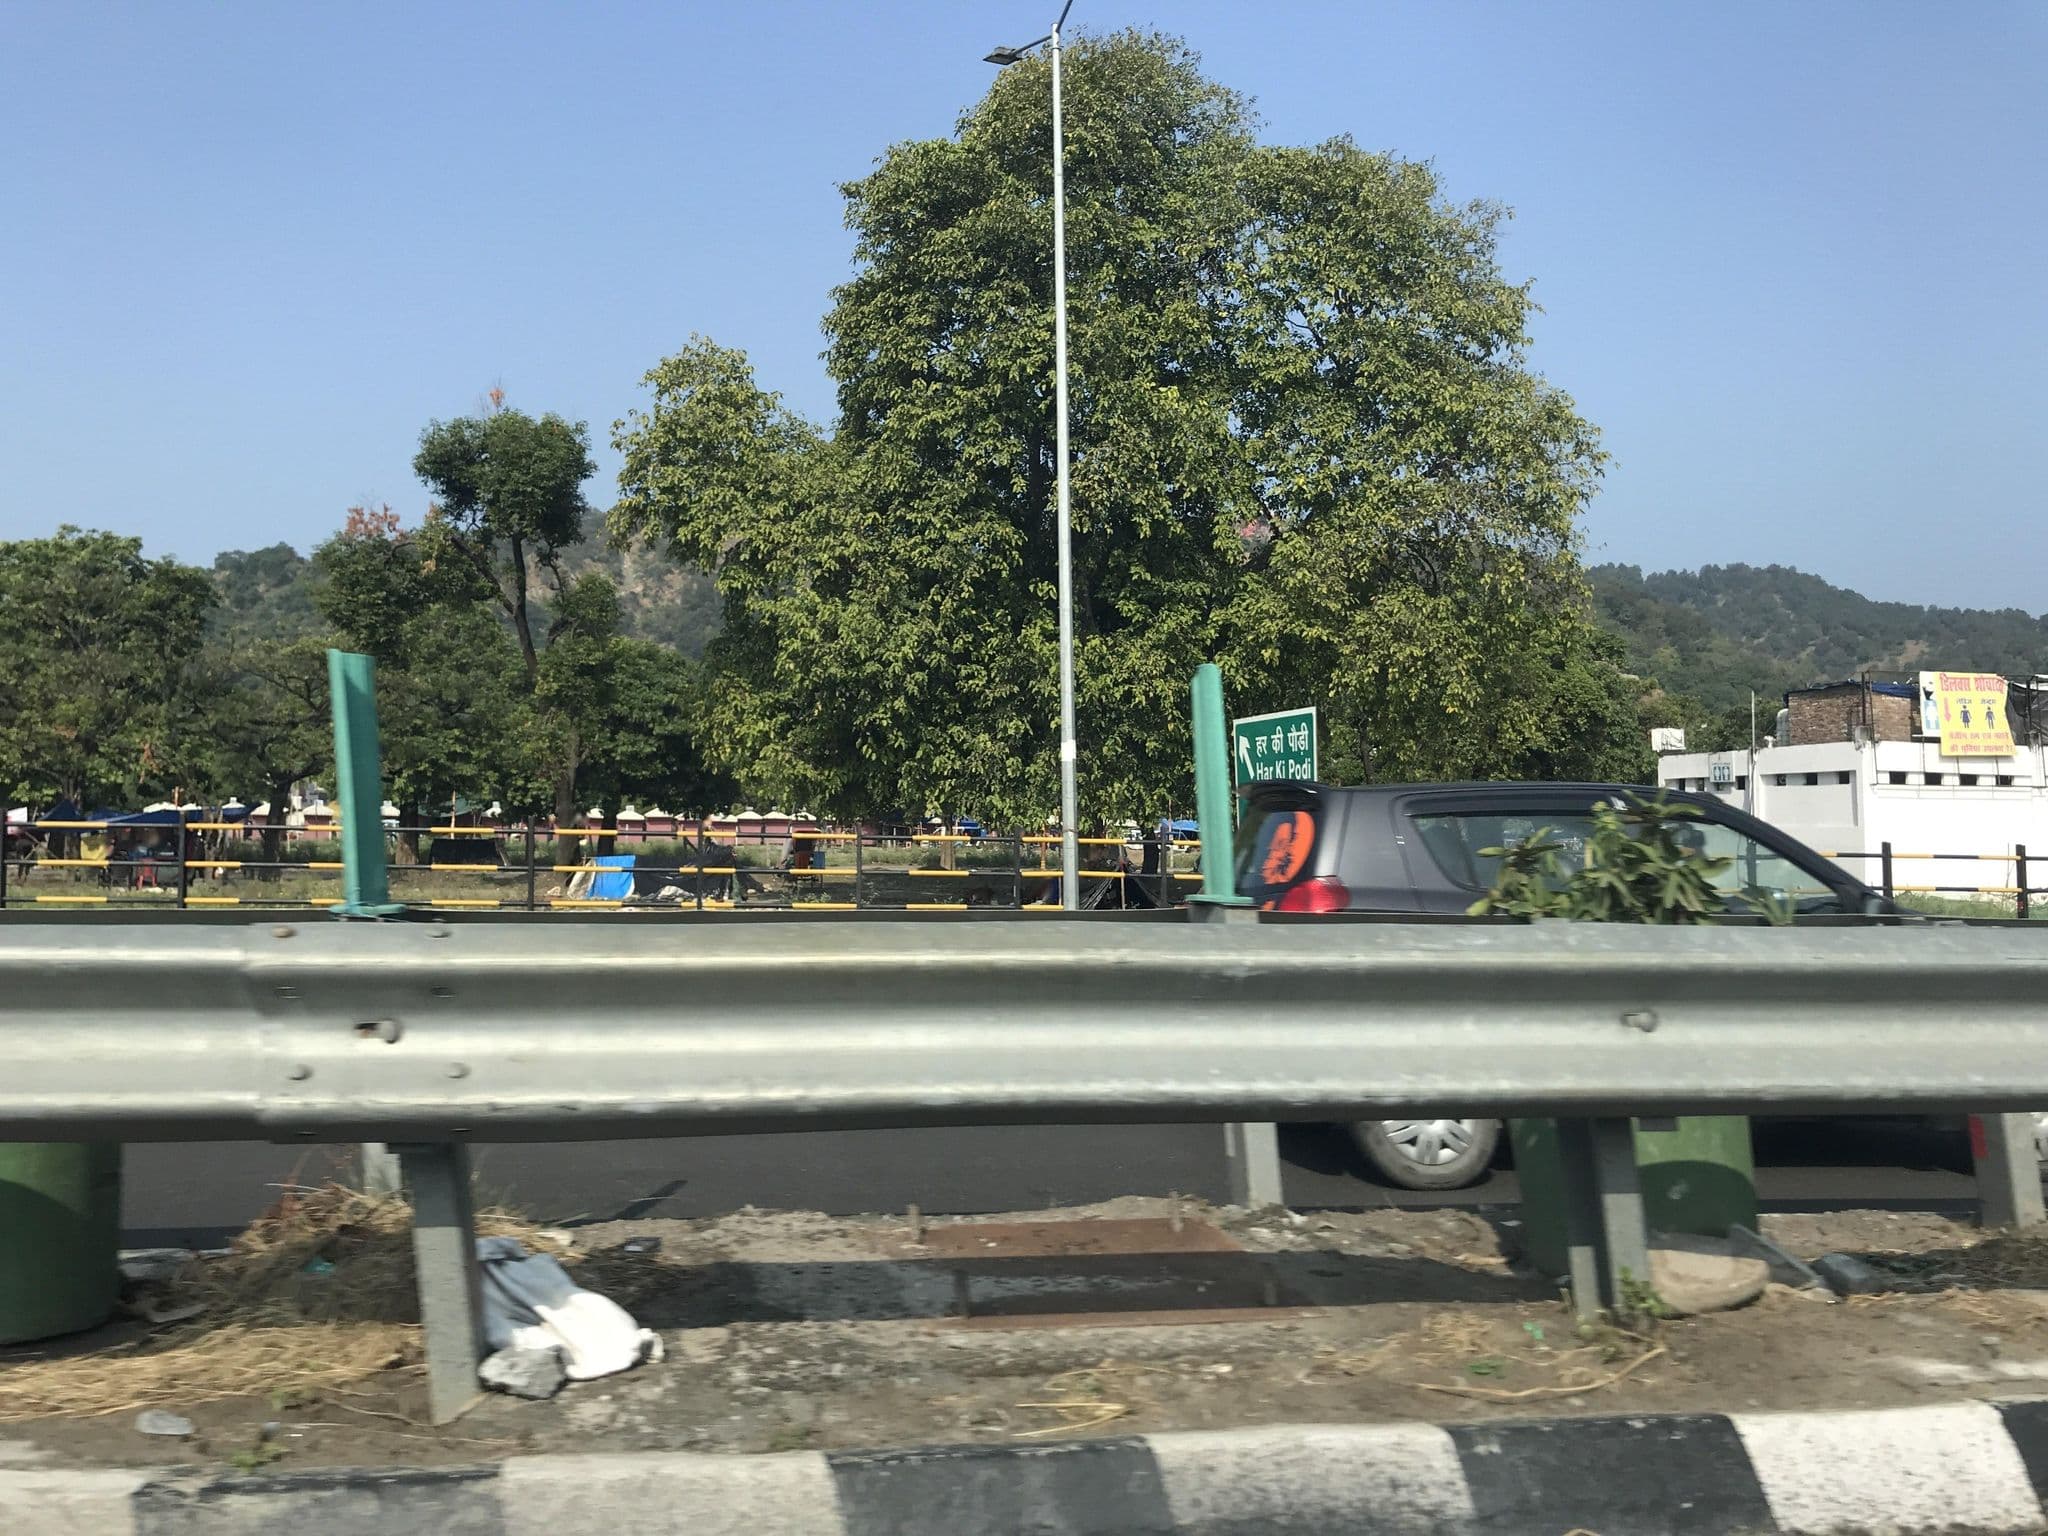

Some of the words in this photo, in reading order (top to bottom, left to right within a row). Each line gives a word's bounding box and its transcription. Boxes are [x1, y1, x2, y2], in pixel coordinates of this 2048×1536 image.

[1255, 736, 1267, 757] हर
[1271, 726, 1283, 753] की
[1256, 762, 1273, 780] Har
[1275, 760, 1286, 779] Ki
[1289, 758, 1311, 780] Podi
